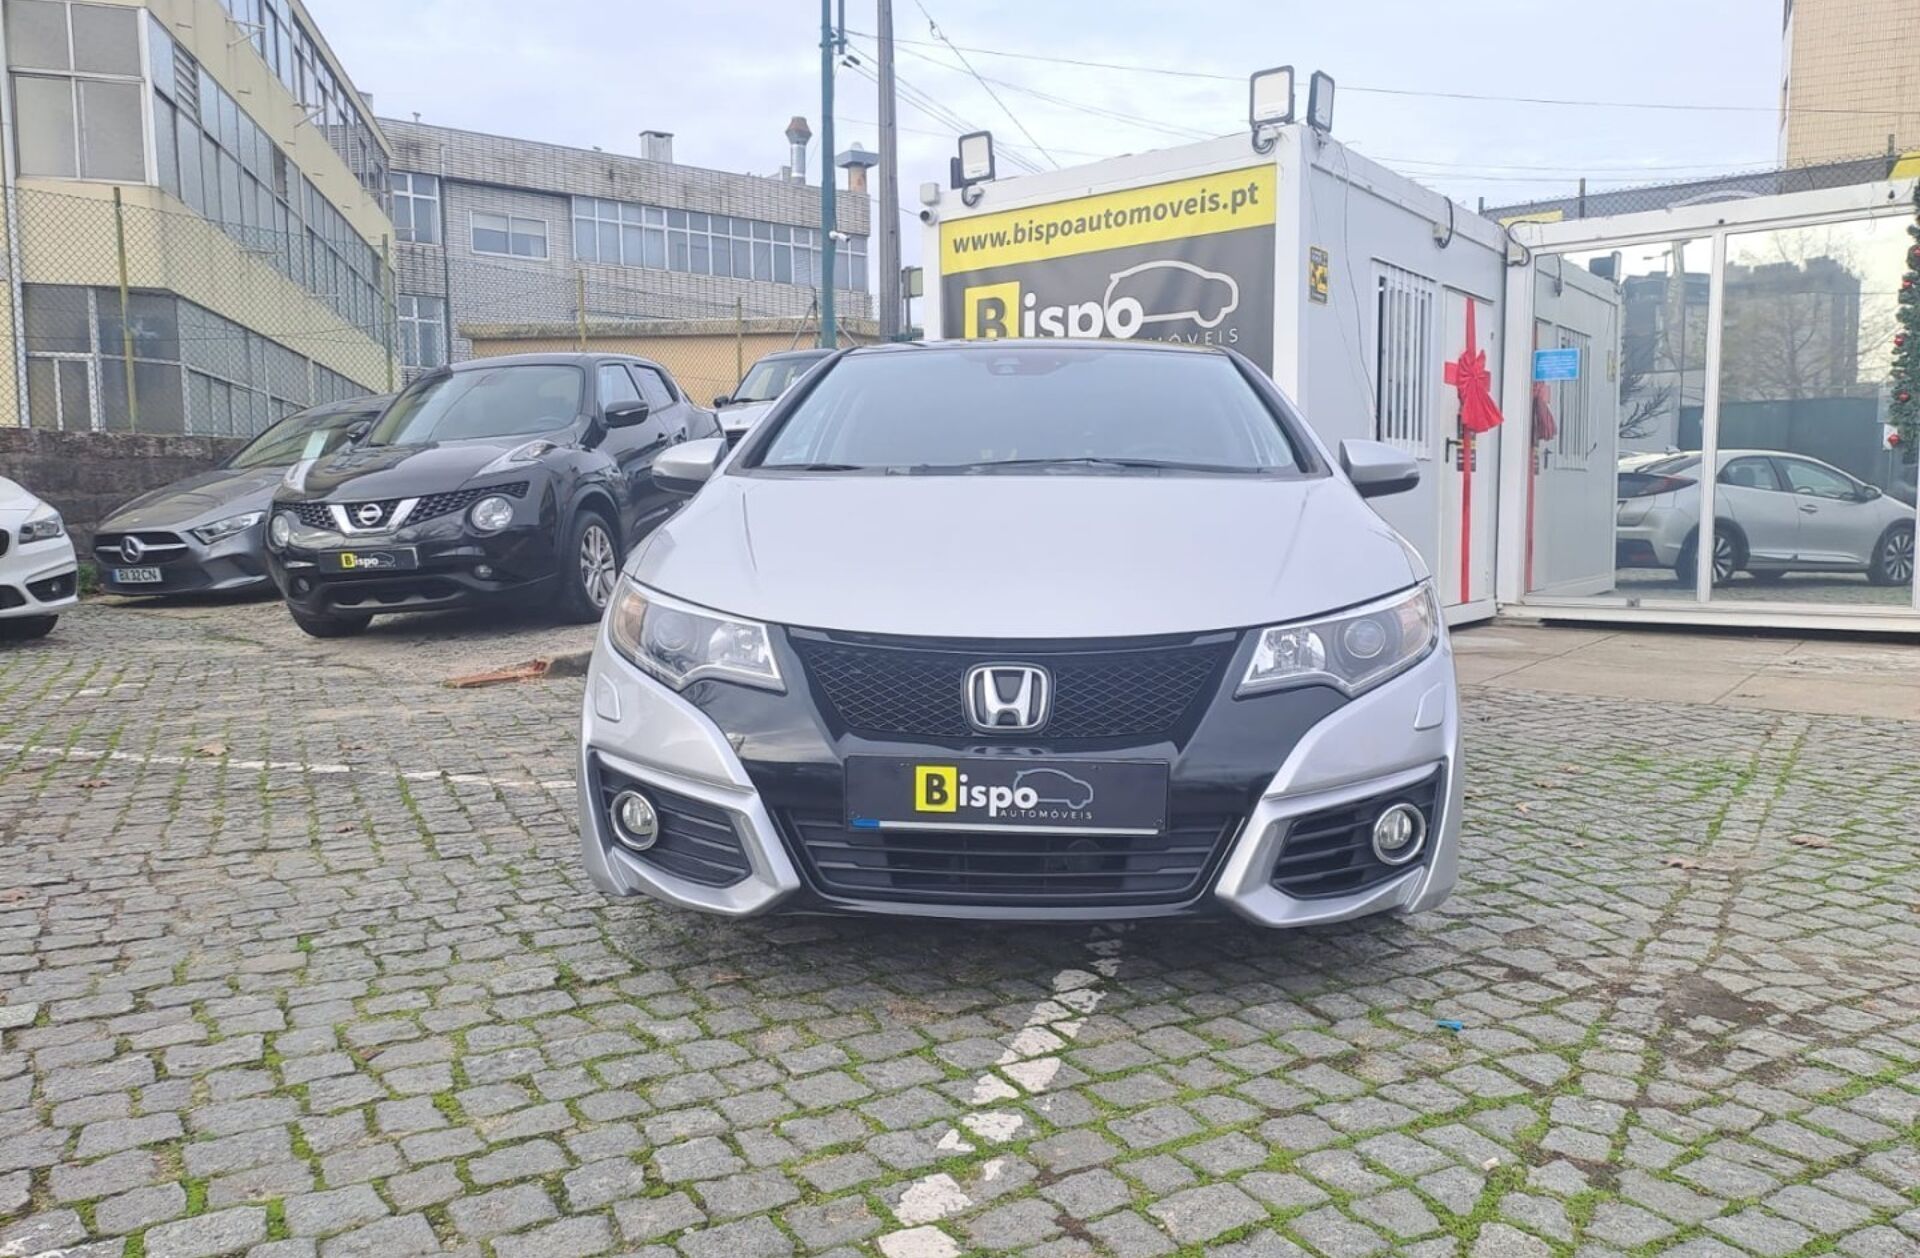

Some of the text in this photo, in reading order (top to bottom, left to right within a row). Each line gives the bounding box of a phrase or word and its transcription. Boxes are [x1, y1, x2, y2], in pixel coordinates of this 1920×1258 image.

[953, 183, 1259, 254] www.bispoautomoveis.pt
[975, 291, 1144, 339] Bispo
[924, 772, 1039, 818] Bispo
[1000, 809, 1093, 820] AUTOMÓVEIS
